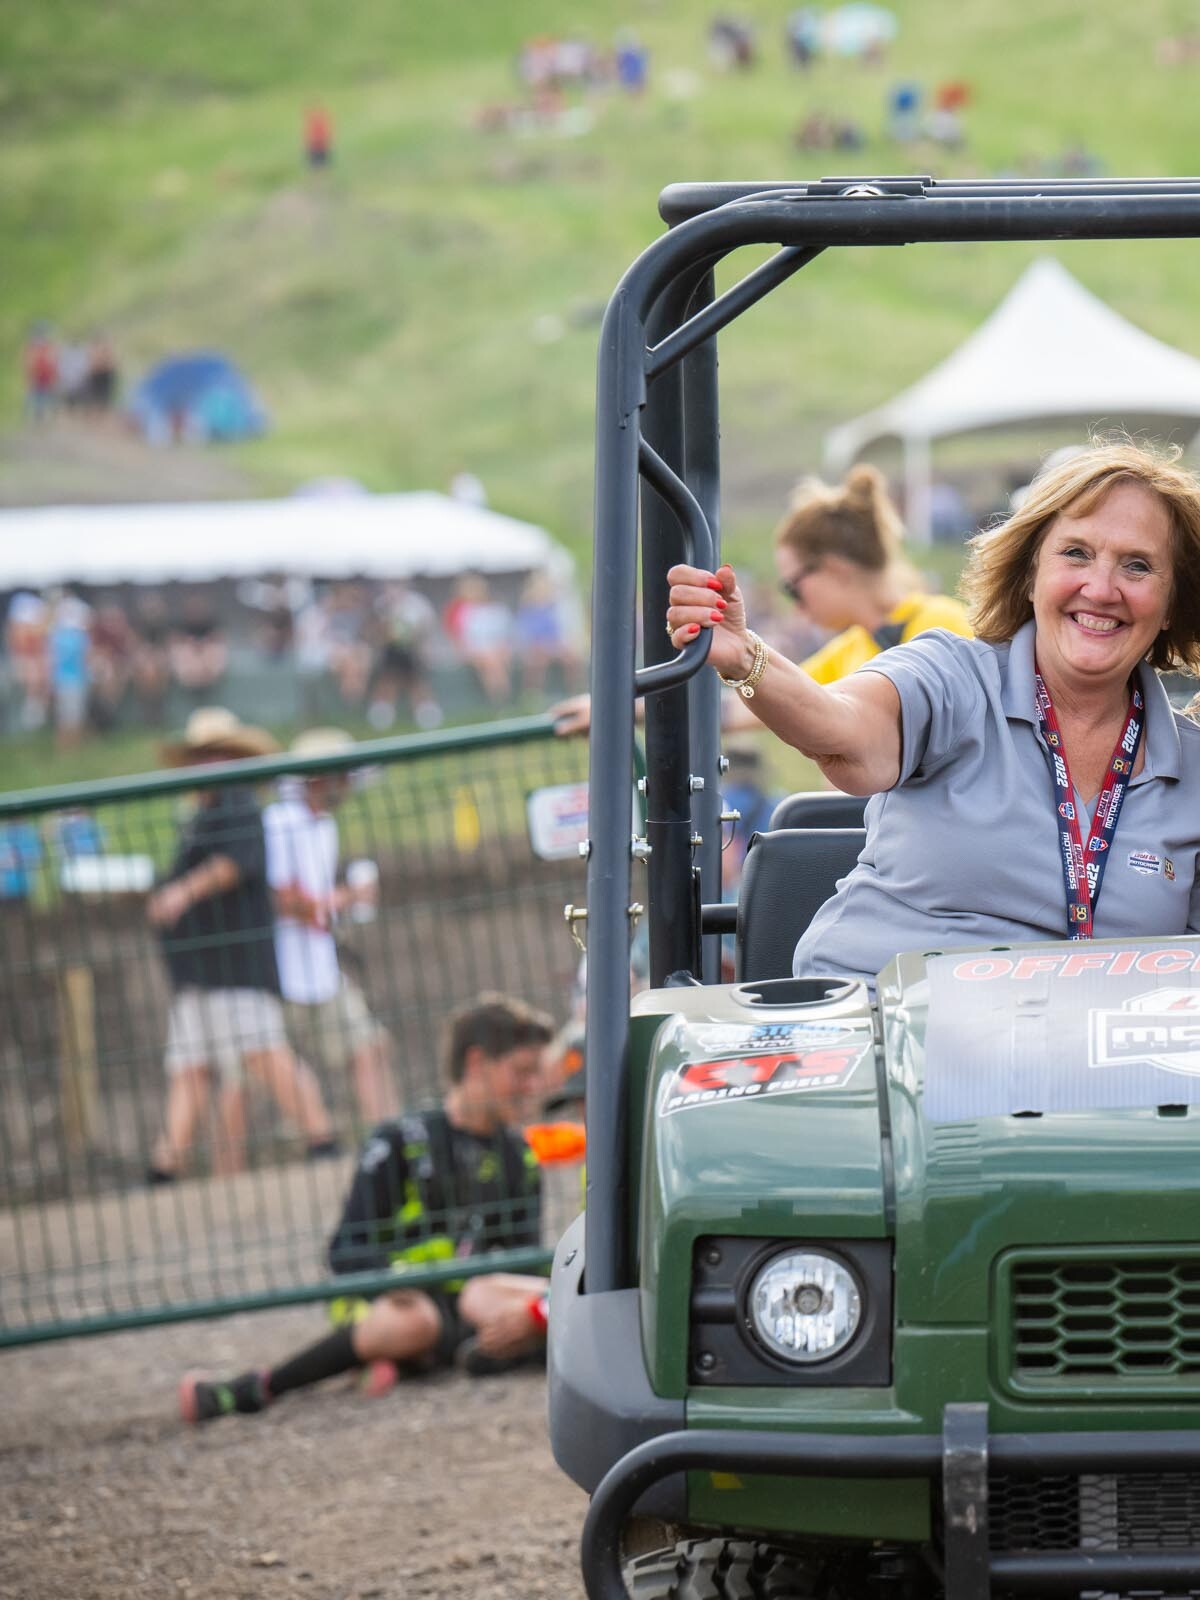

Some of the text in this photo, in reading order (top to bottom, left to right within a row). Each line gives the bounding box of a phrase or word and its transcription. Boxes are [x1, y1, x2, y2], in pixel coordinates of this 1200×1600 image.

[1122, 719, 1140, 754] 2022
[1053, 752, 1069, 788] 2022
[1105, 784, 1123, 829] MOTOCROSS
[1062, 832, 1077, 890] MOTOCROSS
[1076, 907, 1087, 920] 50
[678, 1047, 860, 1091] ETS
[667, 1075, 839, 1109] RACING FUELS
